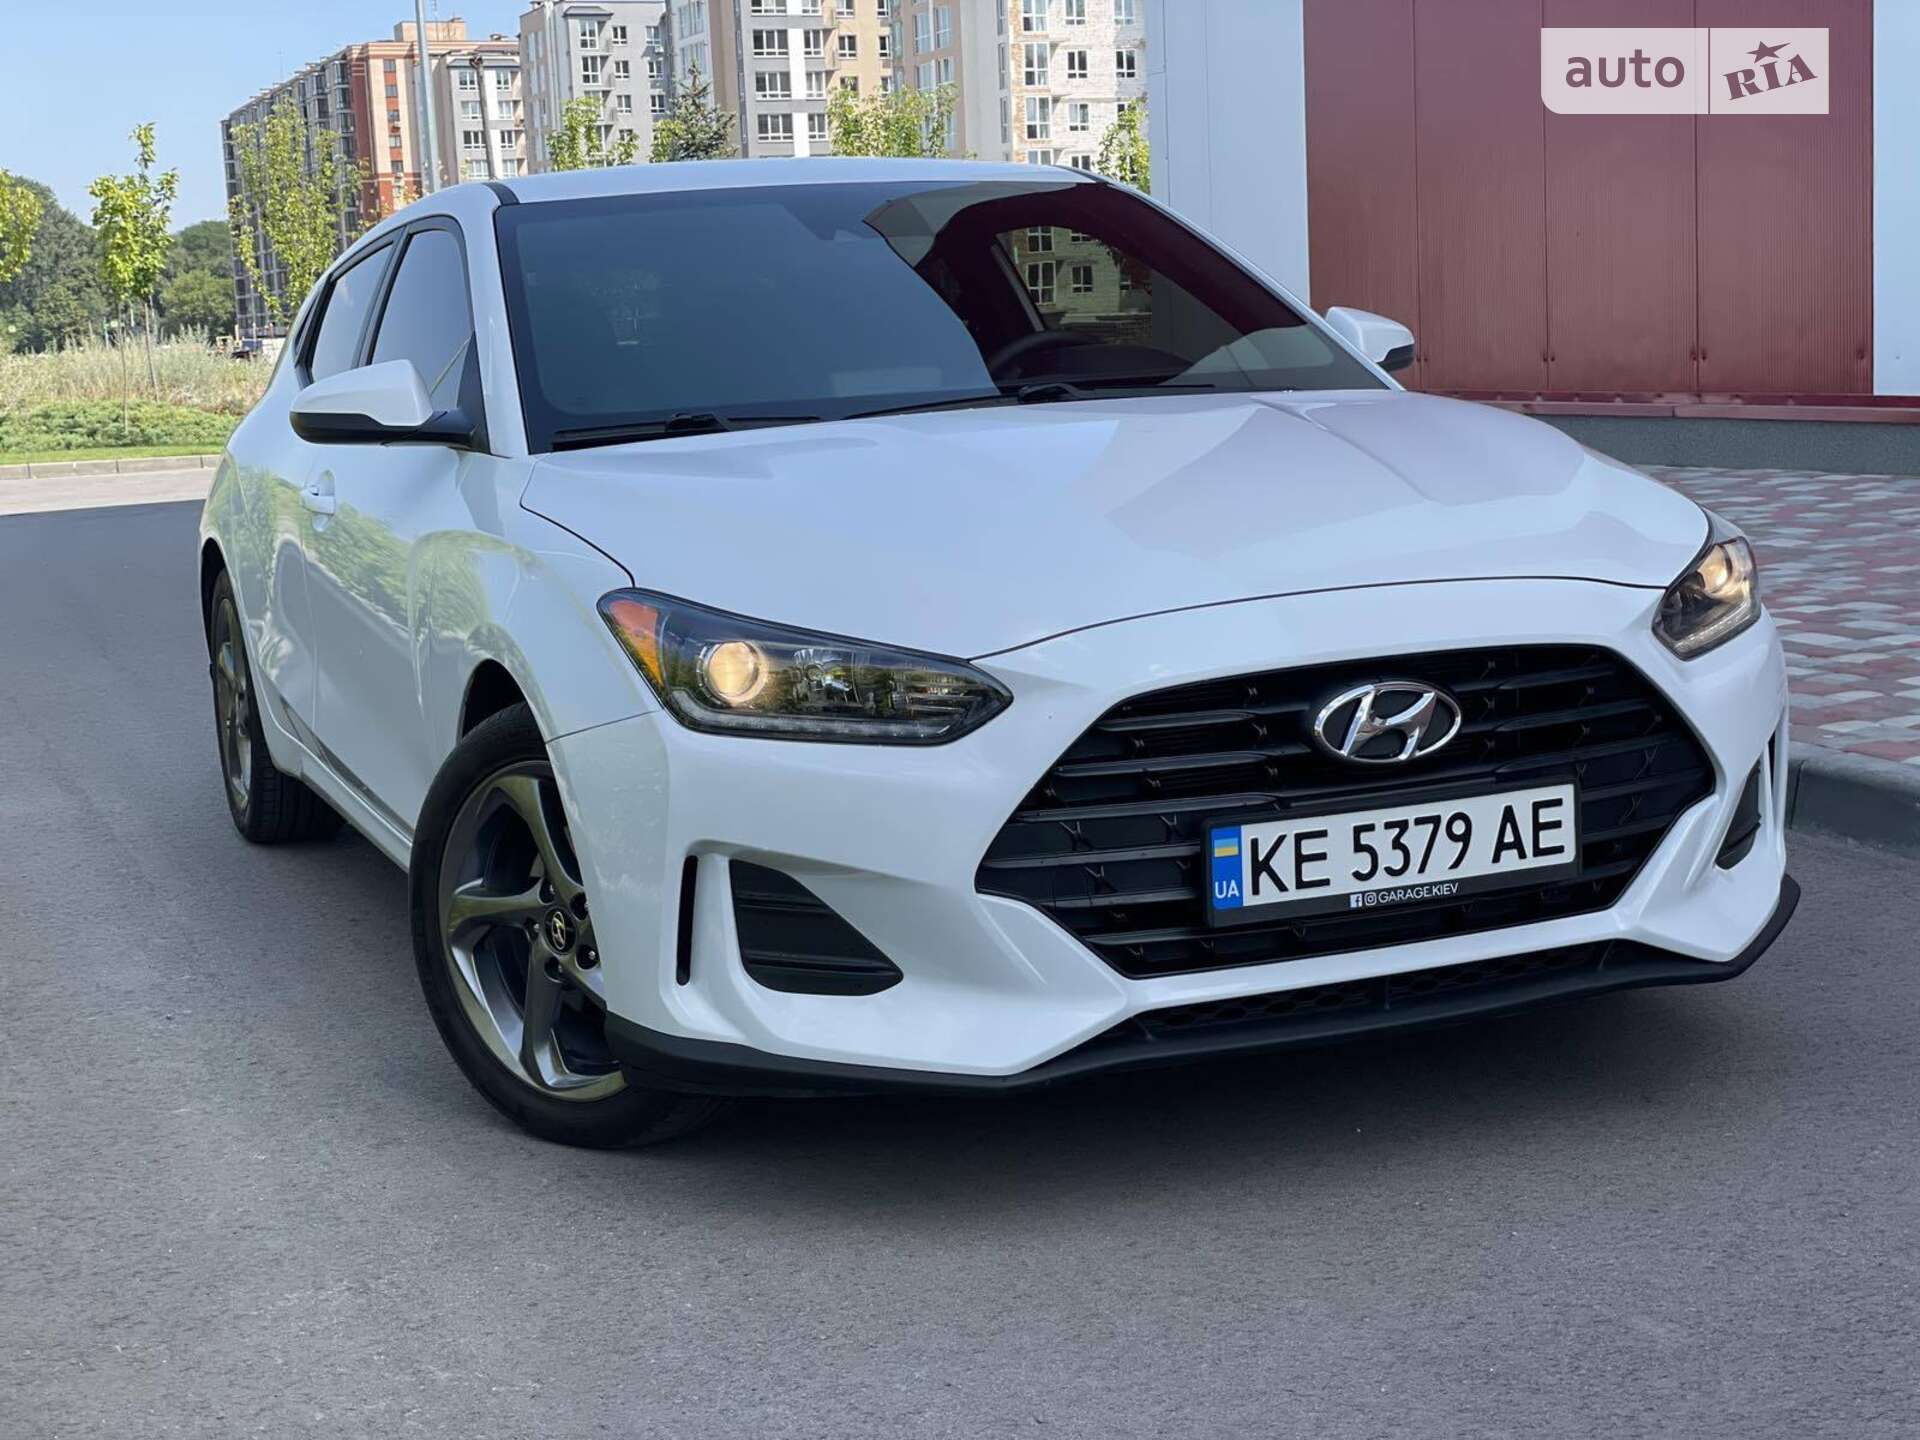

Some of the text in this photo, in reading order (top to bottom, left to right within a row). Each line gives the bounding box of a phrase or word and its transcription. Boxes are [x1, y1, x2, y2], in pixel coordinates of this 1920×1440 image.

[1250, 798, 1565, 895] KE 5379 AE
[1214, 880, 1240, 899] UA
